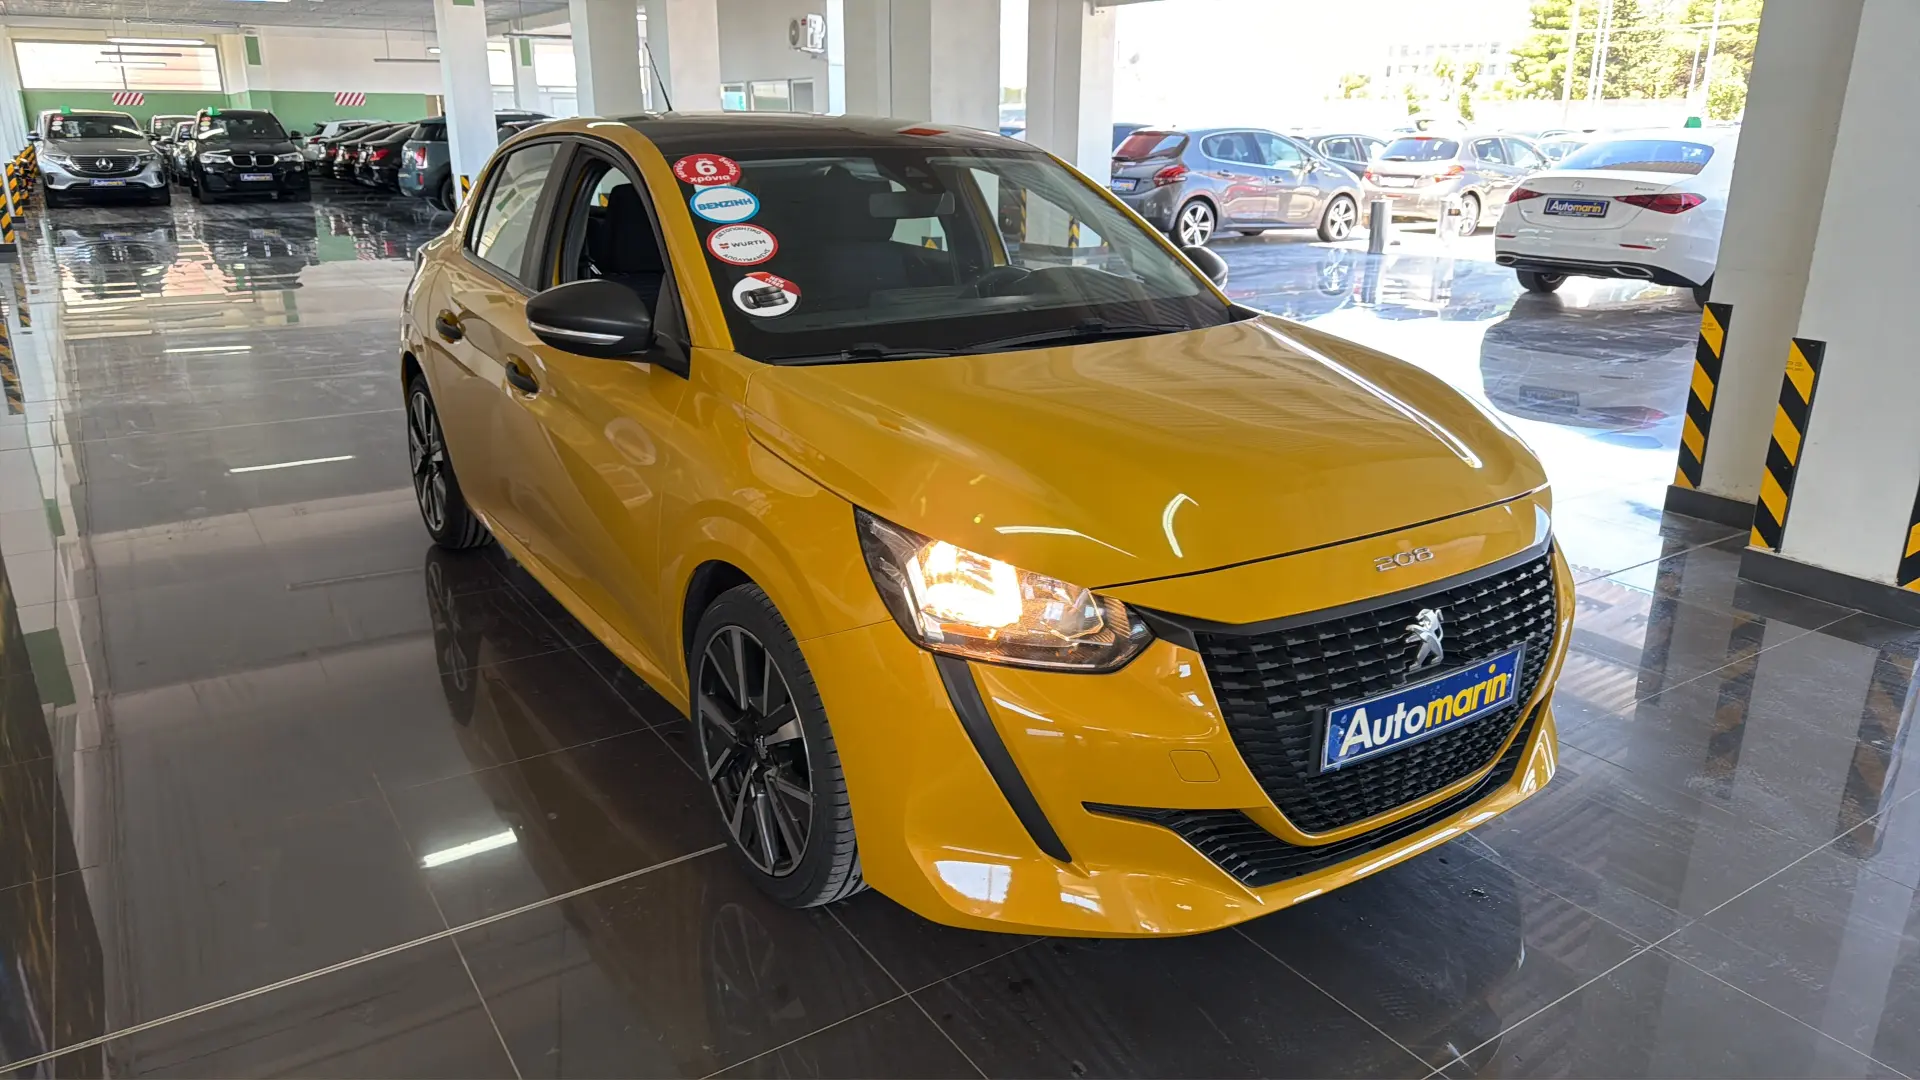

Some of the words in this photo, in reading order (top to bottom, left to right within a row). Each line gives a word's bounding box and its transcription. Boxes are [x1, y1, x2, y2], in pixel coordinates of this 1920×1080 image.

[695, 160, 718, 176] 6
[690, 174, 731, 183] χρόνια
[697, 198, 753, 211] ΒΕΝΖΙΝΗ
[1550, 200, 1602, 213] Automarin
[1374, 547, 1435, 572] 208
[1338, 663, 1508, 757] Automarin
